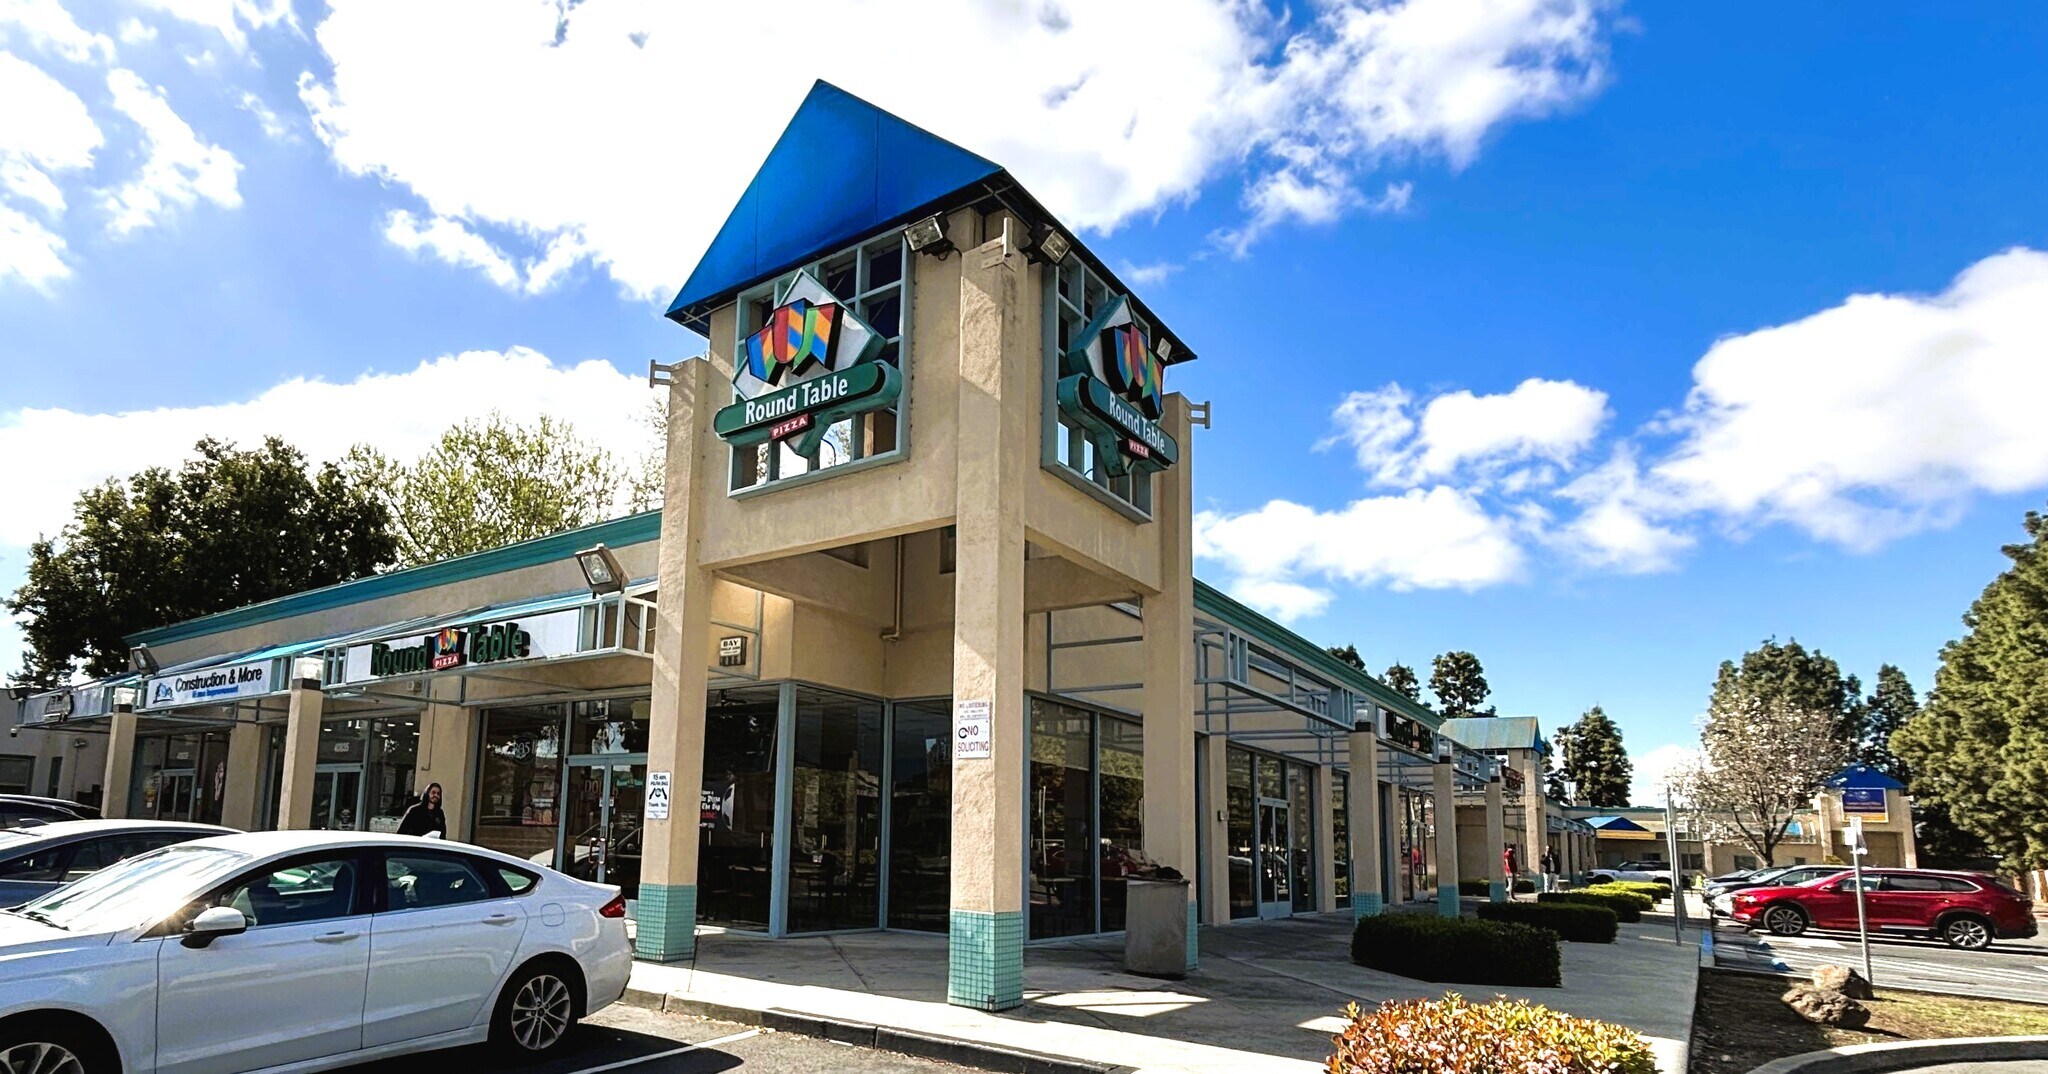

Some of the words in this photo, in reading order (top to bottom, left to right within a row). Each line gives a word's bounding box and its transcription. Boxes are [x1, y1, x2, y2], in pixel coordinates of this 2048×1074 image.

[745, 388, 797, 424] Round
[802, 375, 848, 407] Table
[773, 416, 807, 437] PIZZA
[1109, 391, 1140, 436] Round
[1141, 417, 1165, 454] Table
[1129, 441, 1149, 458] PIZZA
[371, 637, 432, 676] Round
[467, 622, 530, 664] Table
[434, 655, 459, 668] PIZZA
[175, 671, 227, 692] Construction
[228, 668, 236, 684] &
[238, 666, 263, 683] More
[968, 725, 979, 736] NO
[958, 741, 989, 752] SOLICITING
